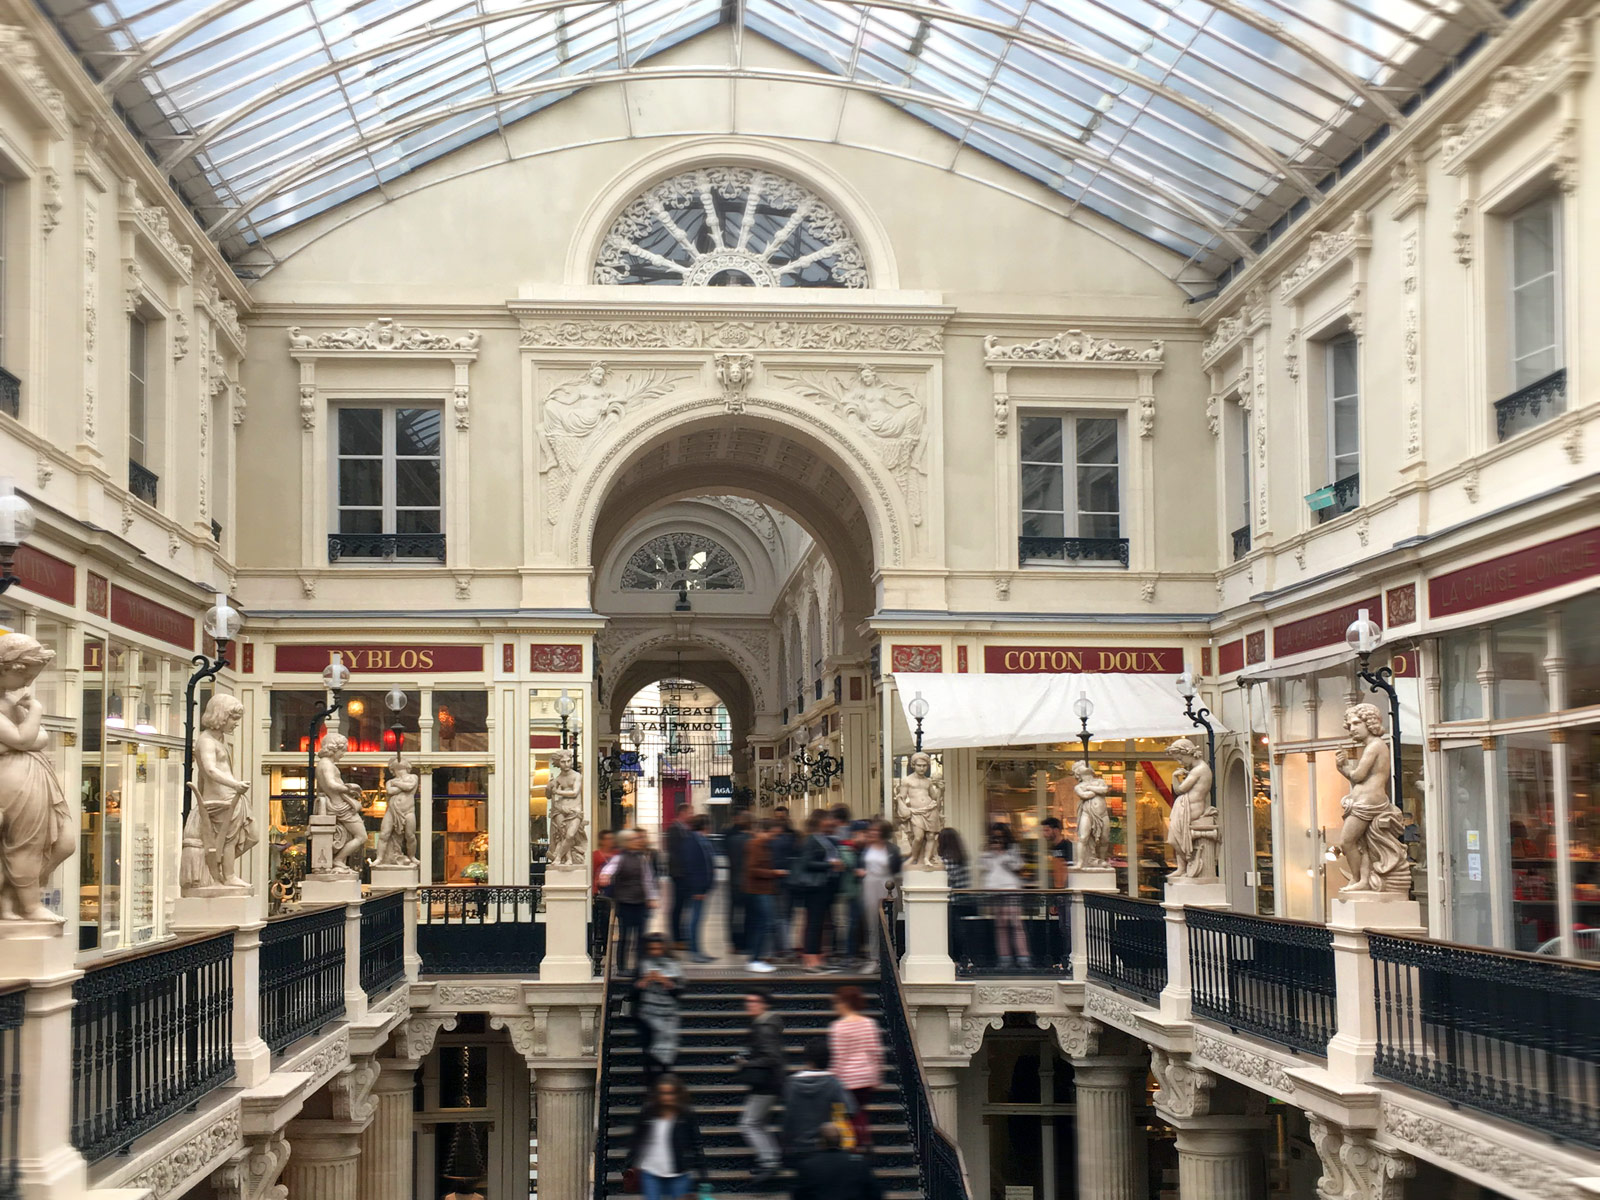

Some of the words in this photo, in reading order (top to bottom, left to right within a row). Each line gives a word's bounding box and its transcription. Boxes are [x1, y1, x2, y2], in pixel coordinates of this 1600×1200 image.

[1441, 581, 1459, 607] LA
[1464, 563, 1517, 600] CHAISE
[1525, 540, 1598, 585] LONGUE
[327, 649, 434, 669] BYBLOS
[1004, 650, 1084, 671] COTON
[1098, 651, 1166, 672] DOUX
[714, 787, 732, 795] AGA
